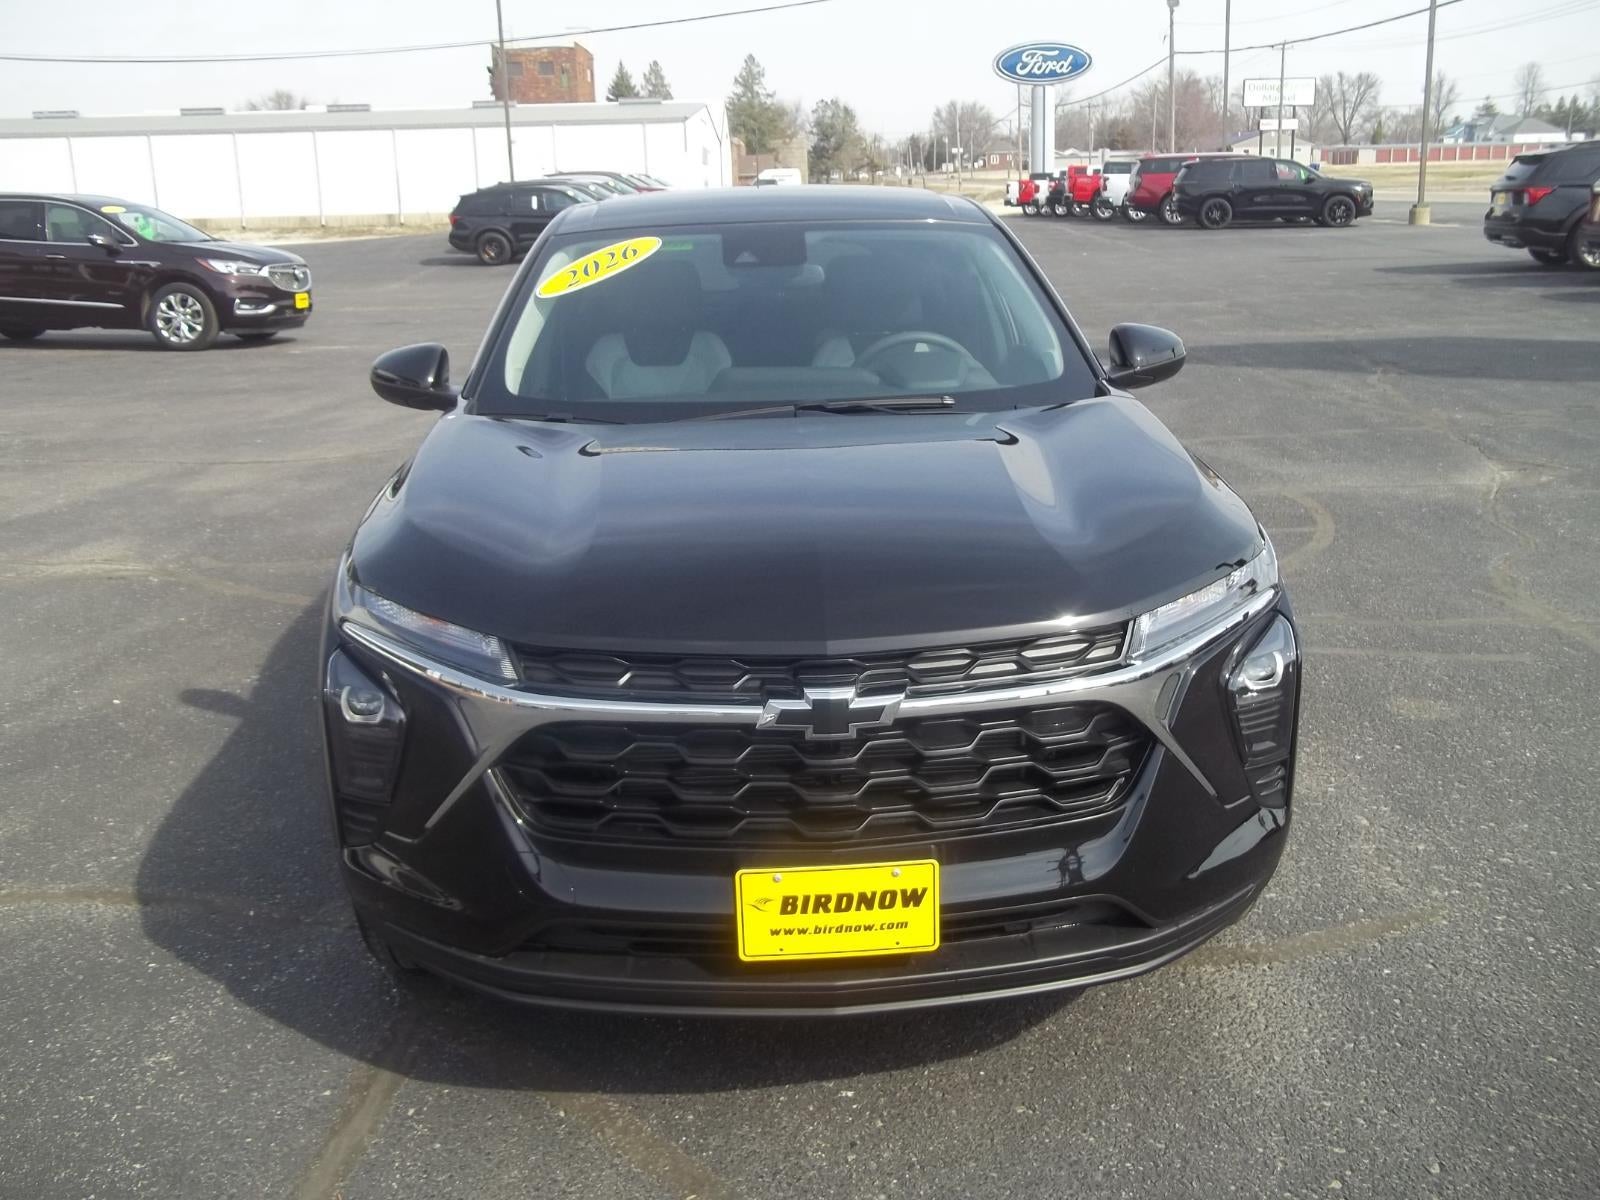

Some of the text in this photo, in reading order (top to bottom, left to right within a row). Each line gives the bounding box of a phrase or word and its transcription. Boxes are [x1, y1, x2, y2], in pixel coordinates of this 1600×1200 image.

[1016, 49, 1074, 75] Ford
[567, 245, 638, 287] 2026
[779, 887, 929, 916] BIRDNOW
[769, 921, 909, 937] www.birdnow.com
